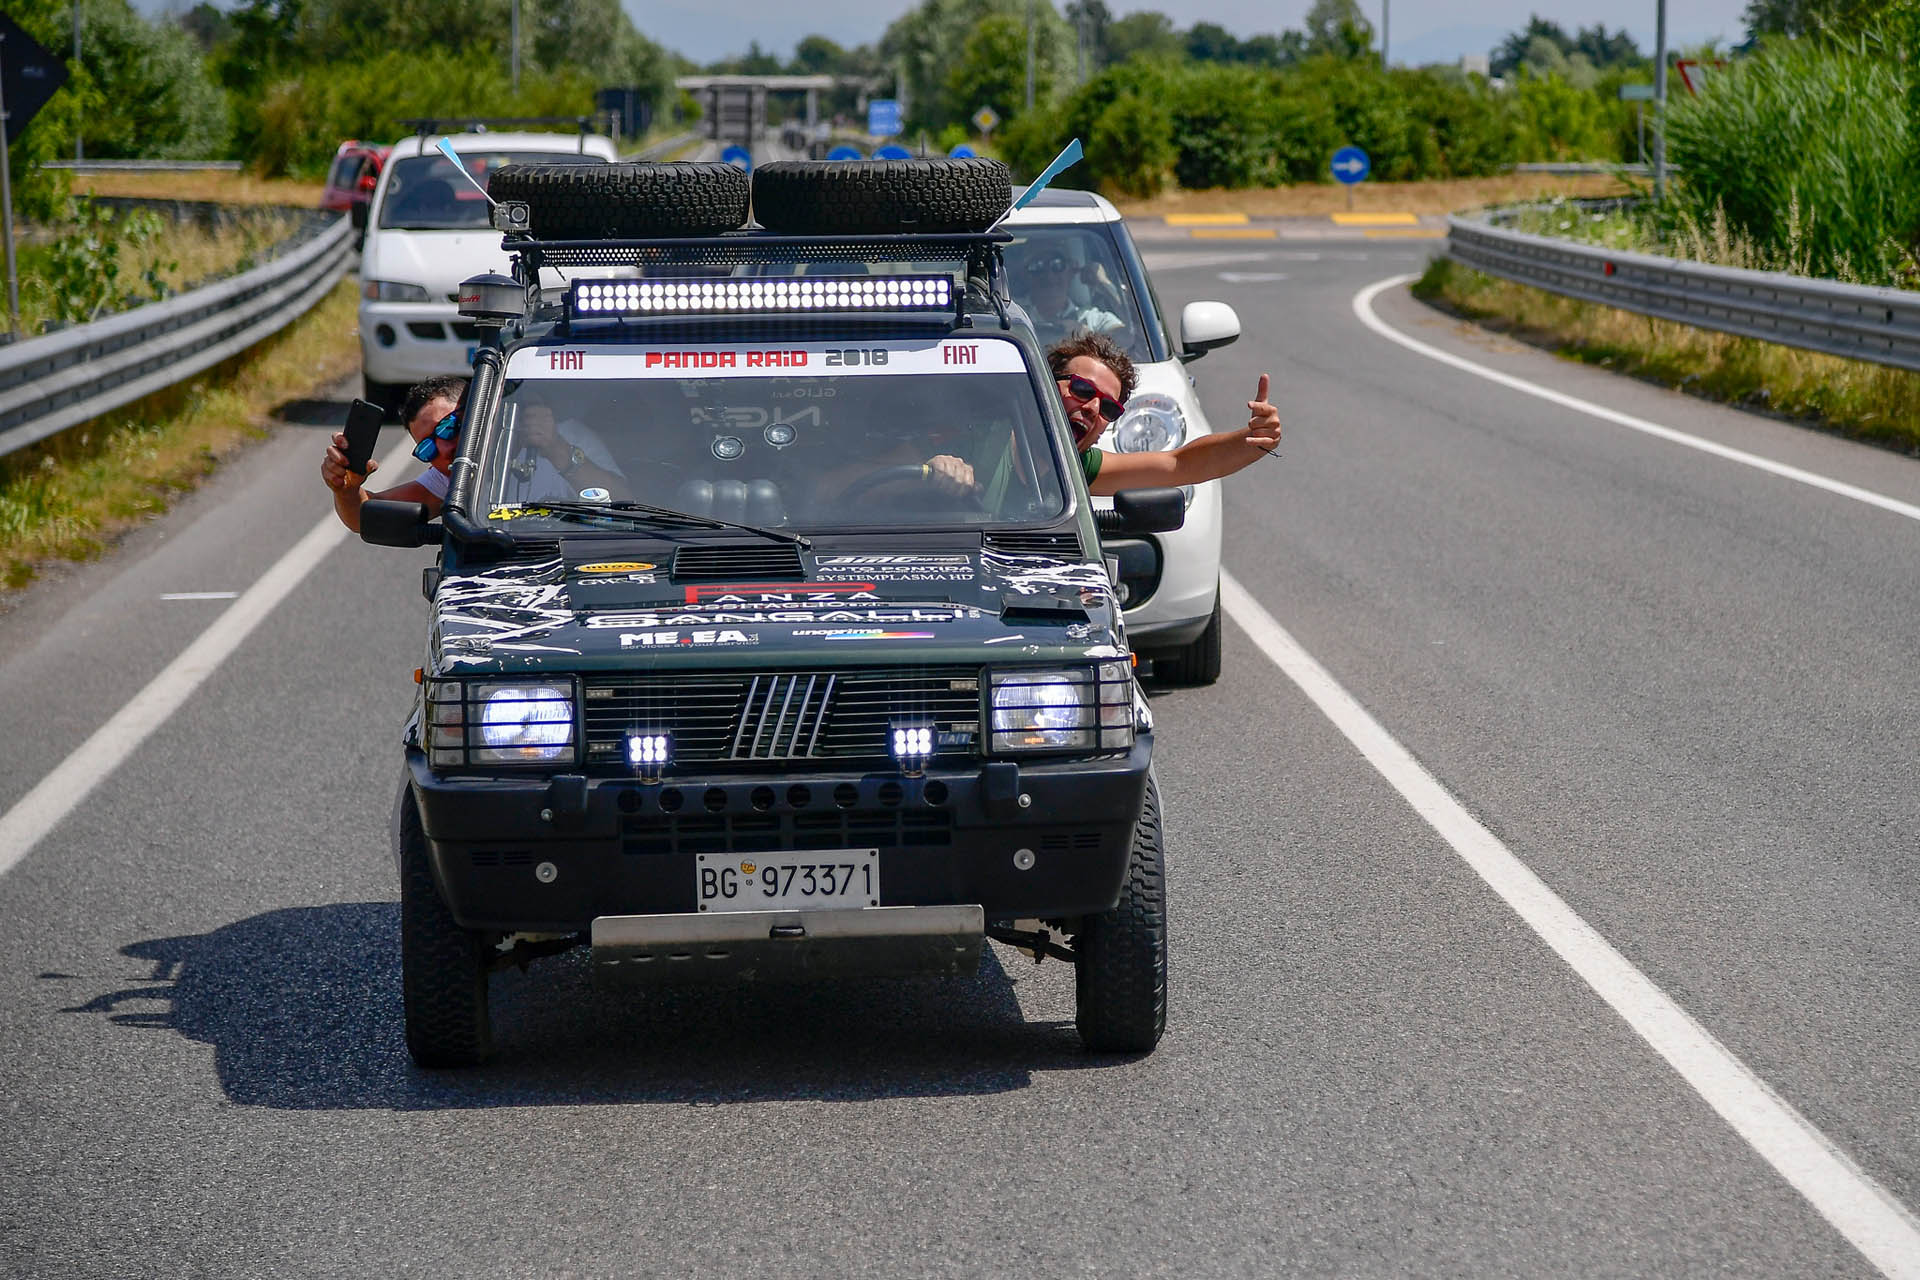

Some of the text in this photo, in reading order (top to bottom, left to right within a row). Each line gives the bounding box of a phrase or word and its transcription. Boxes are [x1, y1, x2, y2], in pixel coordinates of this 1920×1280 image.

[551, 350, 586, 370] FIAT
[645, 351, 737, 369] PANDA
[825, 348, 889, 366] 2018
[943, 345, 979, 365] FIAT
[816, 573, 975, 581] SYSTEMPLASMA HD
[685, 582, 880, 604] PANZA
[586, 609, 963, 629] SANGALLI
[619, 629, 748, 646] ME.EA
[791, 628, 884, 637] unoprima
[701, 867, 738, 899] BG
[761, 863, 871, 897] 973371
